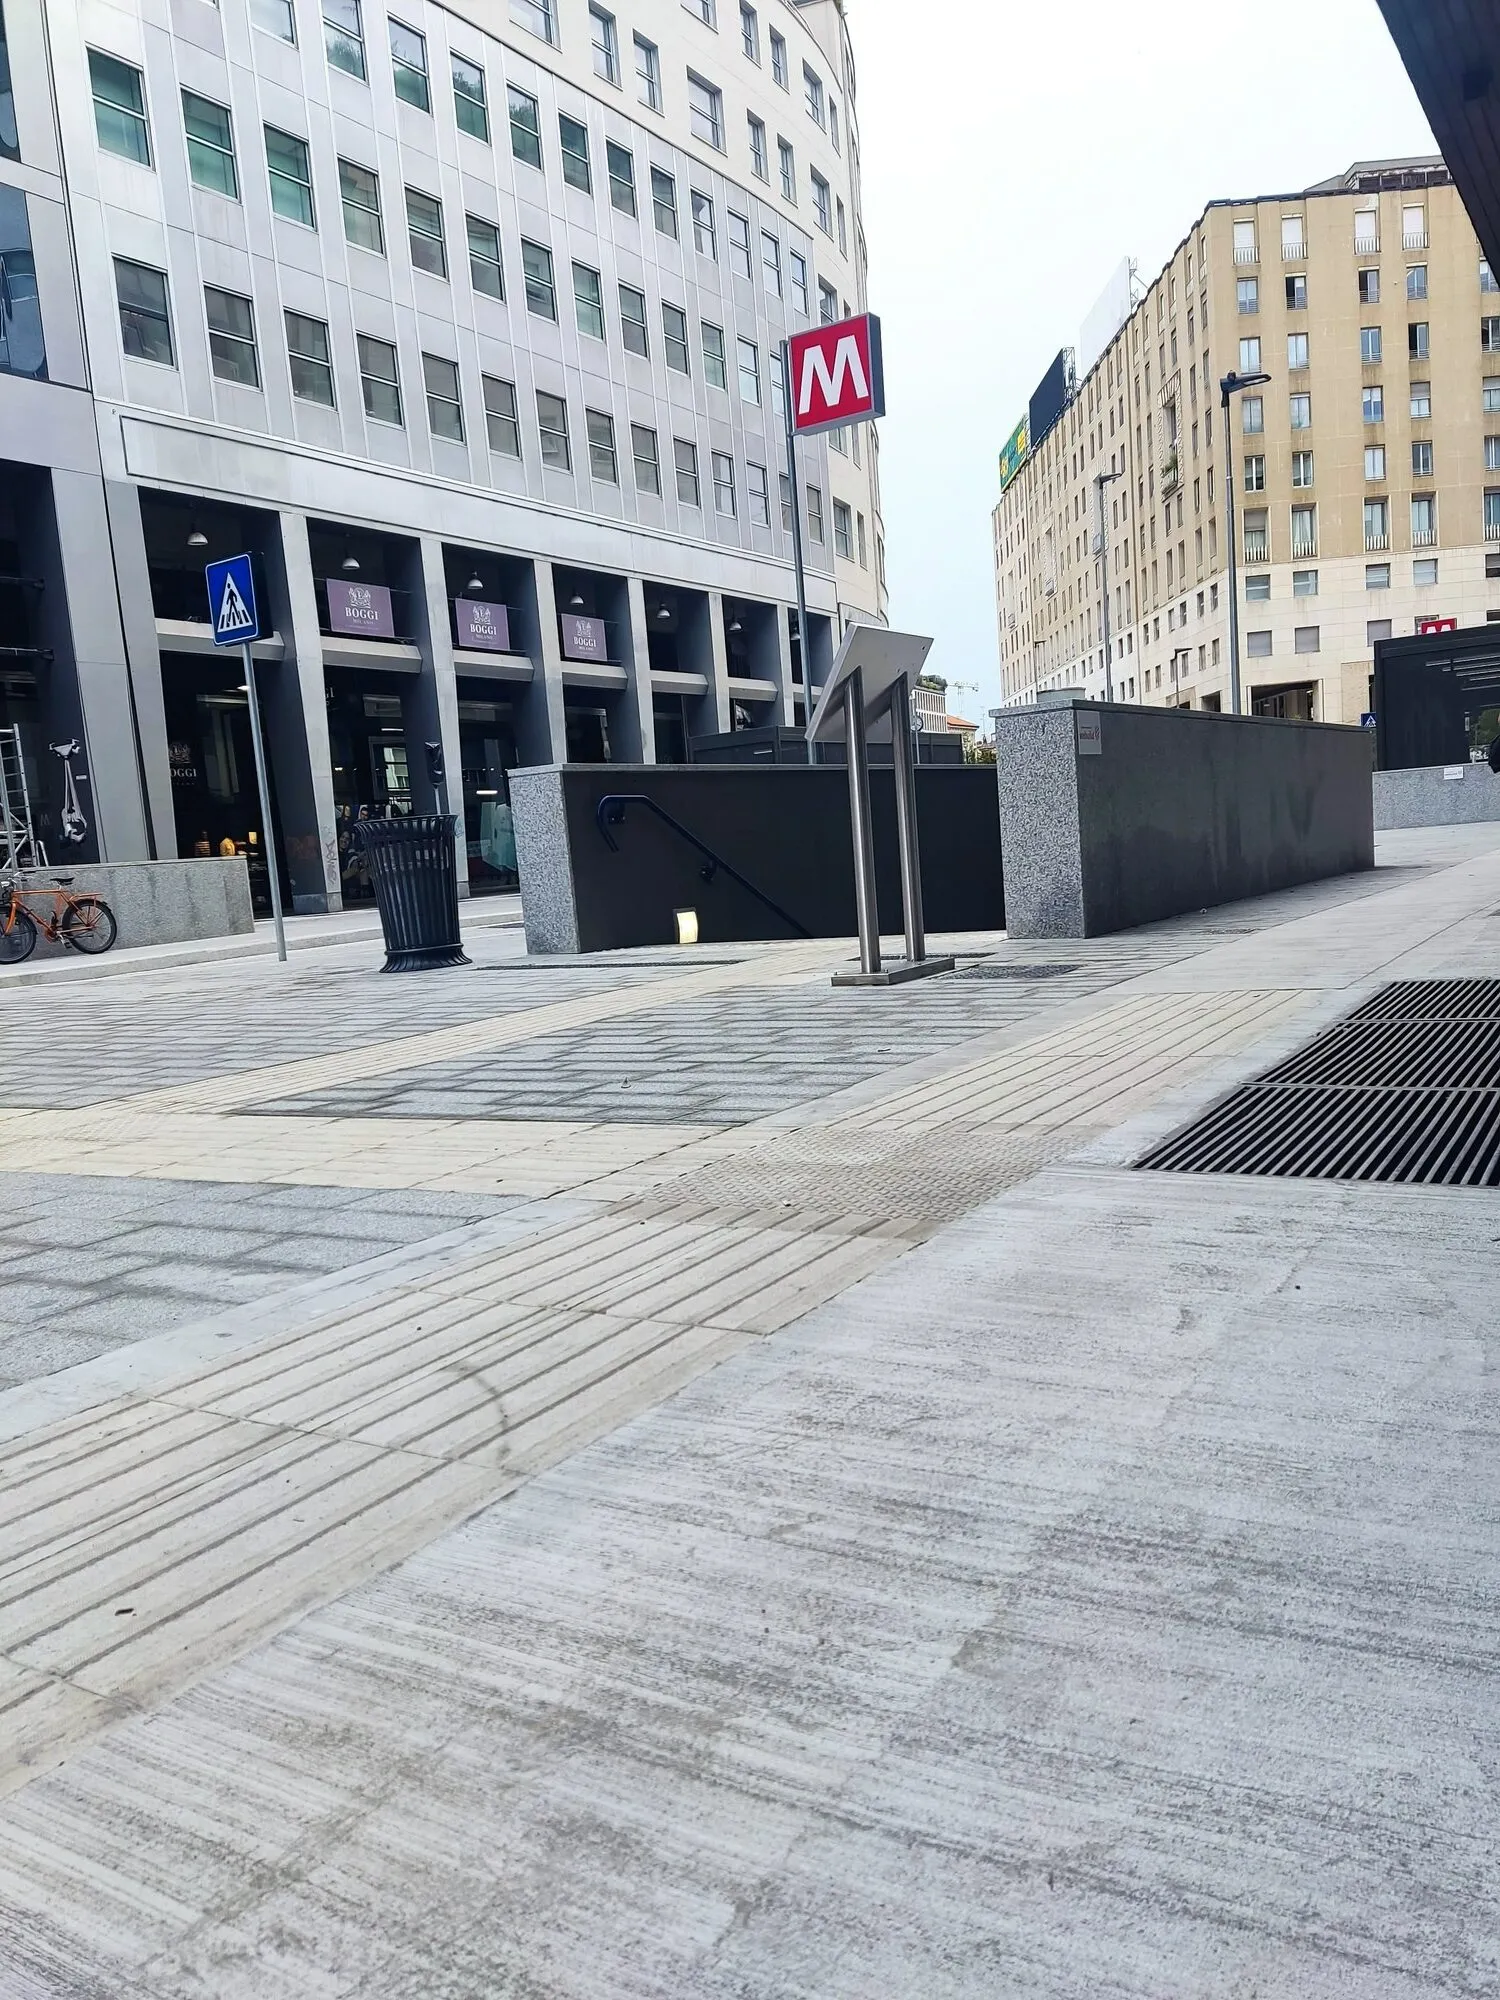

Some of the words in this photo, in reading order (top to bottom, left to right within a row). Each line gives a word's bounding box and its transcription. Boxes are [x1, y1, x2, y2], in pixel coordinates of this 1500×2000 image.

[798, 335, 869, 415] M
[345, 606, 379, 621] BOGGI
[470, 623, 497, 636] BOGGI
[573, 636, 597, 648] BOGGI
[170, 767, 197, 778] OGGI
